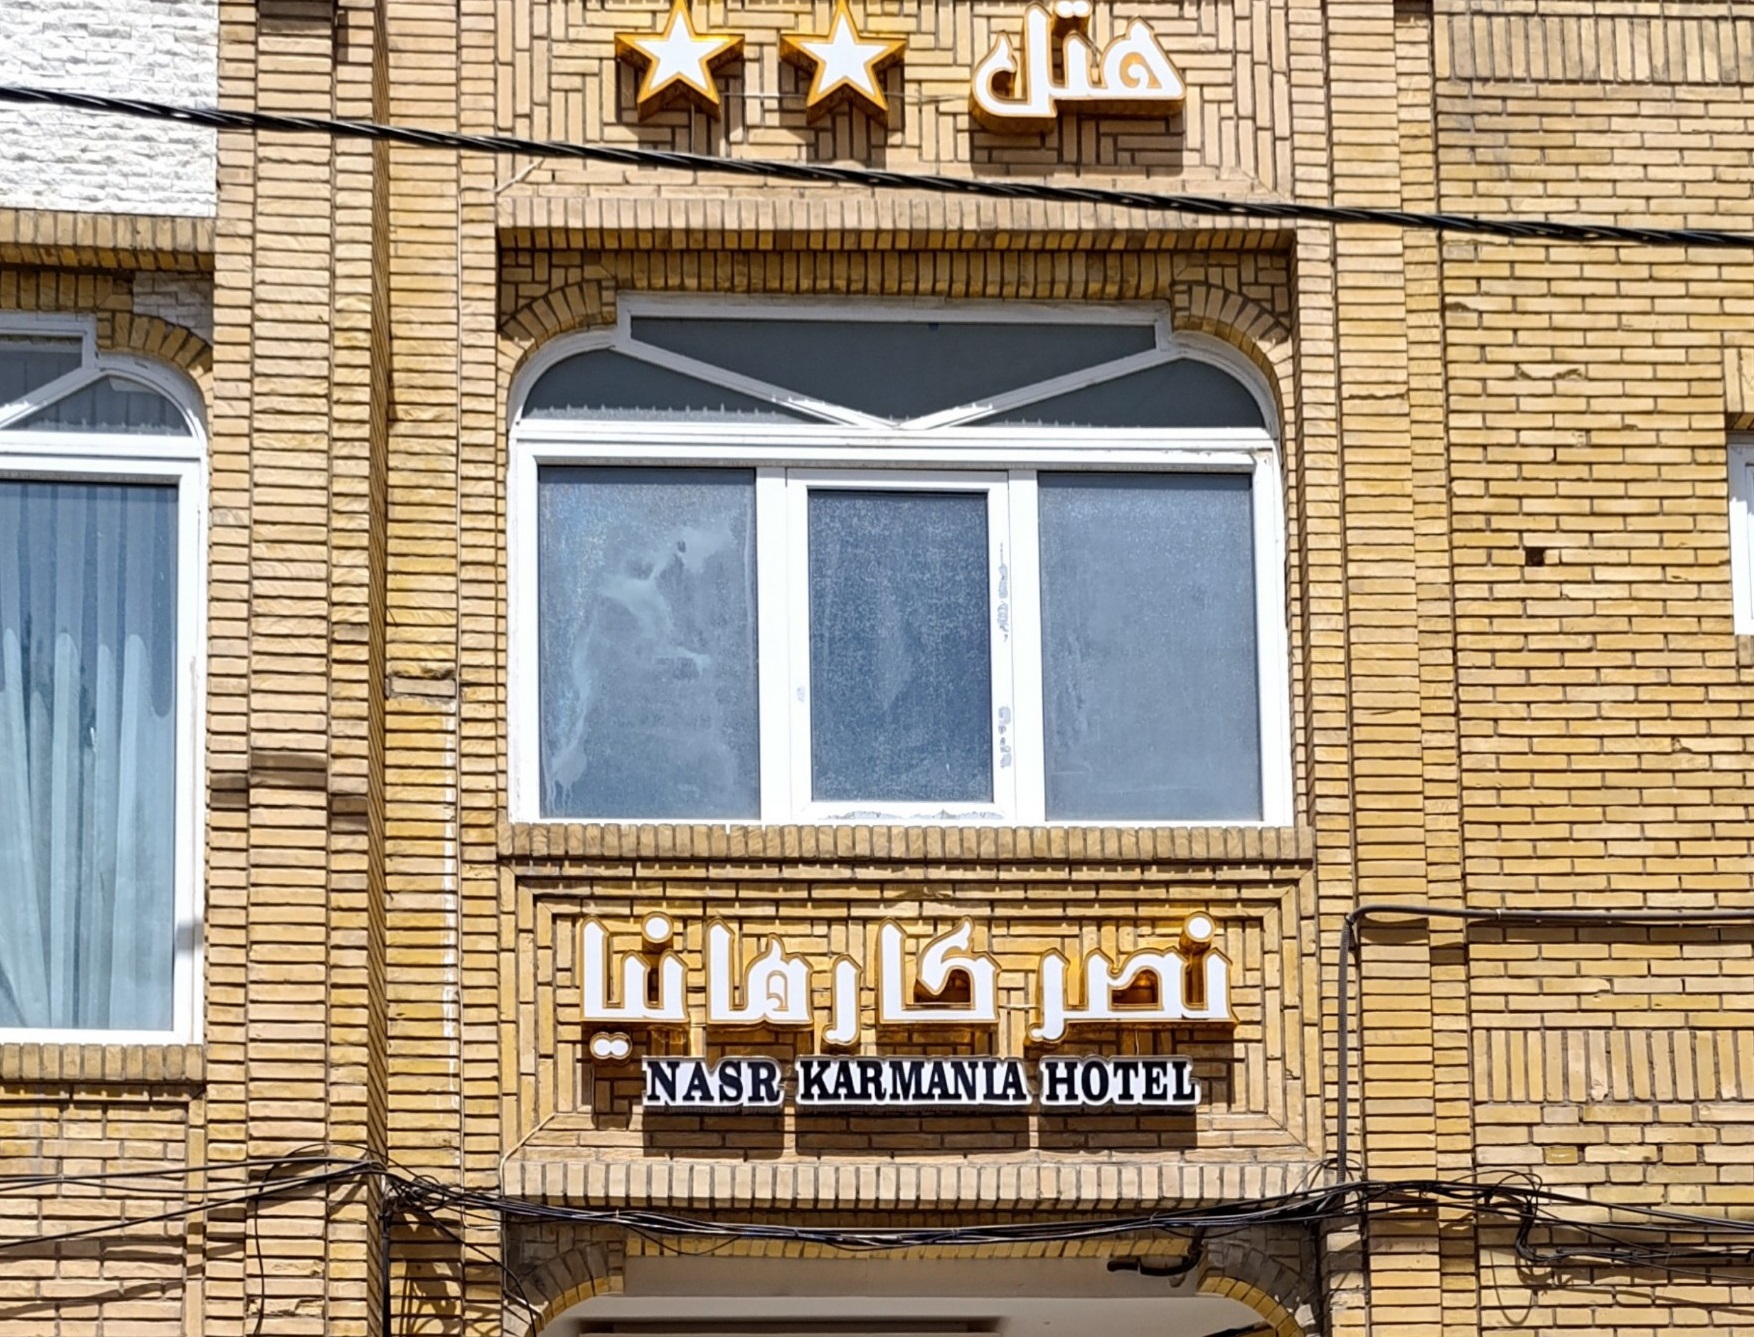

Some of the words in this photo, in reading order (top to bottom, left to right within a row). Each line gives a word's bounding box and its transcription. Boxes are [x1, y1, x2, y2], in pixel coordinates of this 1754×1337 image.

[974, 0, 1184, 117] هتل
[1029, 913, 1231, 1042] نصر
[647, 1060, 781, 1102] NASR
[801, 1060, 1027, 1101] KARMANIA
[1046, 1060, 1196, 1101] HOTEL
